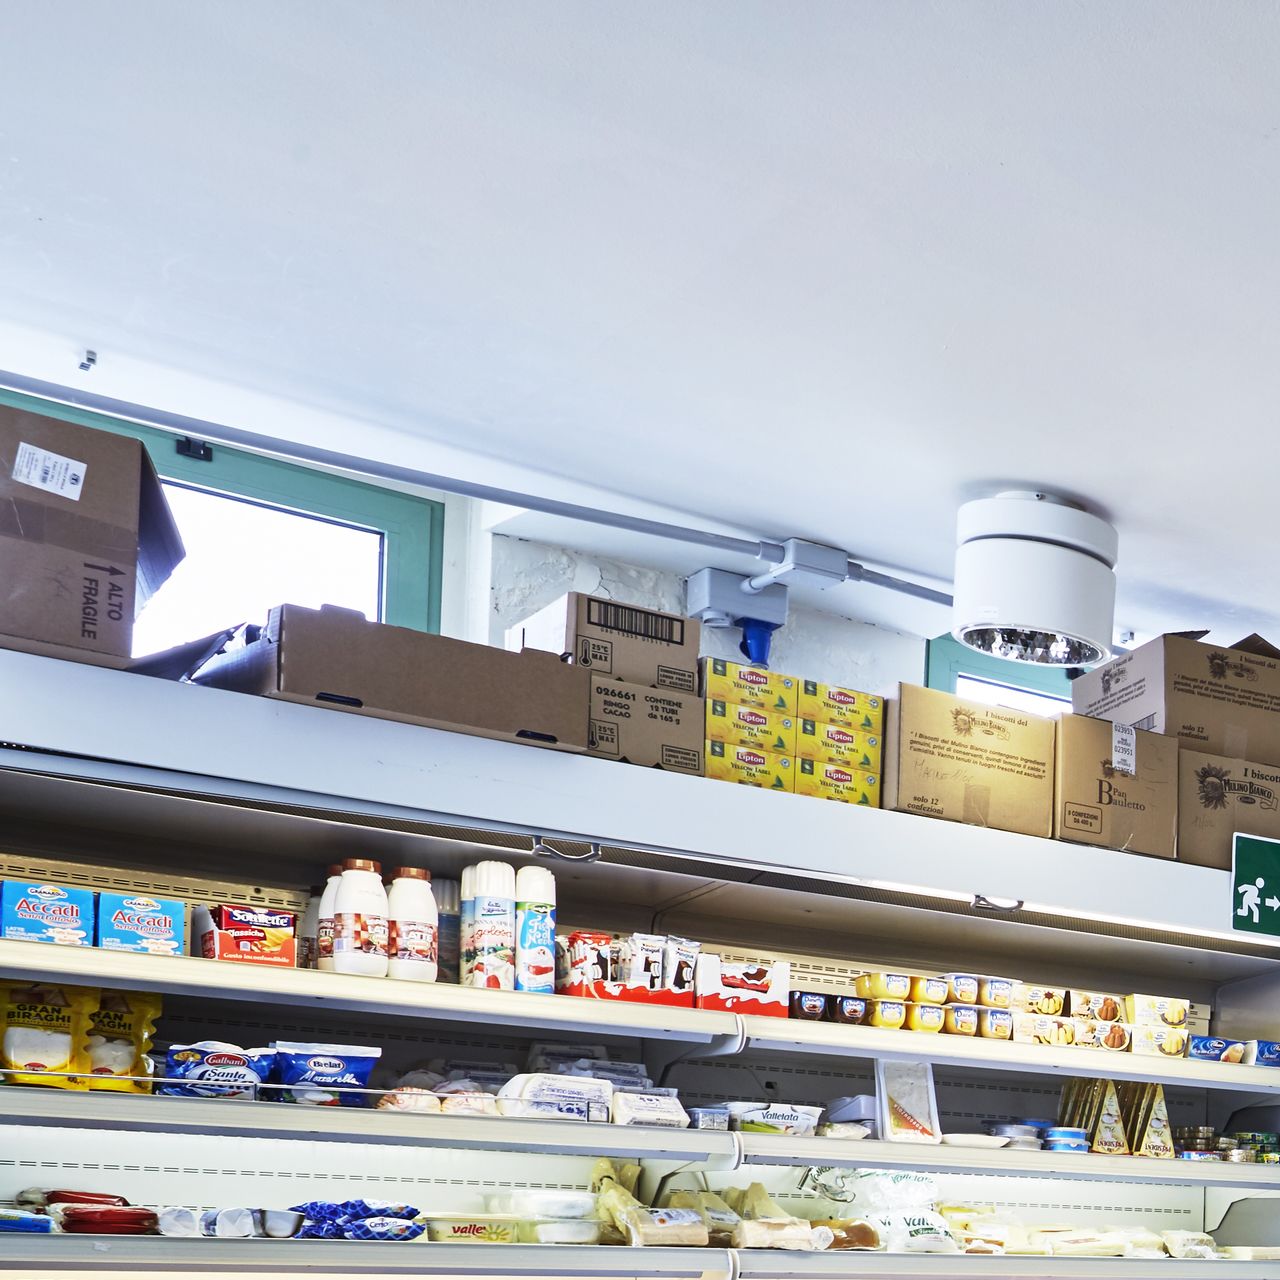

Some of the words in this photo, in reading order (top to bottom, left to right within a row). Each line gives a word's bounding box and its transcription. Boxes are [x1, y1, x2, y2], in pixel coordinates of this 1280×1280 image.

[107, 582, 123, 621] ALTO
[81, 577, 98, 640] FRAGILE
[591, 653, 609, 663] MAX
[739, 670, 768, 685] Lipton
[595, 685, 637, 702] 026661
[828, 691, 856, 705] Lipton
[603, 700, 630, 711] RINGO
[644, 696, 683, 709] CONTIENE
[603, 708, 632, 719] CACAO
[650, 704, 659, 713] 12
[660, 706, 679, 716] TUBI
[659, 714, 673, 723] 165
[738, 712, 767, 726] Lipton
[991, 713, 1015, 724] biscotti
[1017, 718, 1028, 726] del
[827, 730, 854, 744] Lipton
[737, 752, 765, 766] Lipton
[825, 769, 852, 783] Lipton
[1113, 787, 1127, 798] Pan
[1223, 778, 1248, 793] MULINO
[1249, 782, 1272, 800] BIANCO
[913, 795, 928, 803] solo
[907, 803, 944, 815] confezioni
[15, 898, 80, 918] Accadì
[18, 911, 45, 922] Senza
[112, 910, 173, 929] Accadì
[223, 951, 249, 961] Gusto
[16, 1002, 62, 1016] GRAN
[7, 1010, 72, 1024] BIRAGHI
[207, 1054, 245, 1067] Galbani
[206, 1068, 247, 1081] Santa
